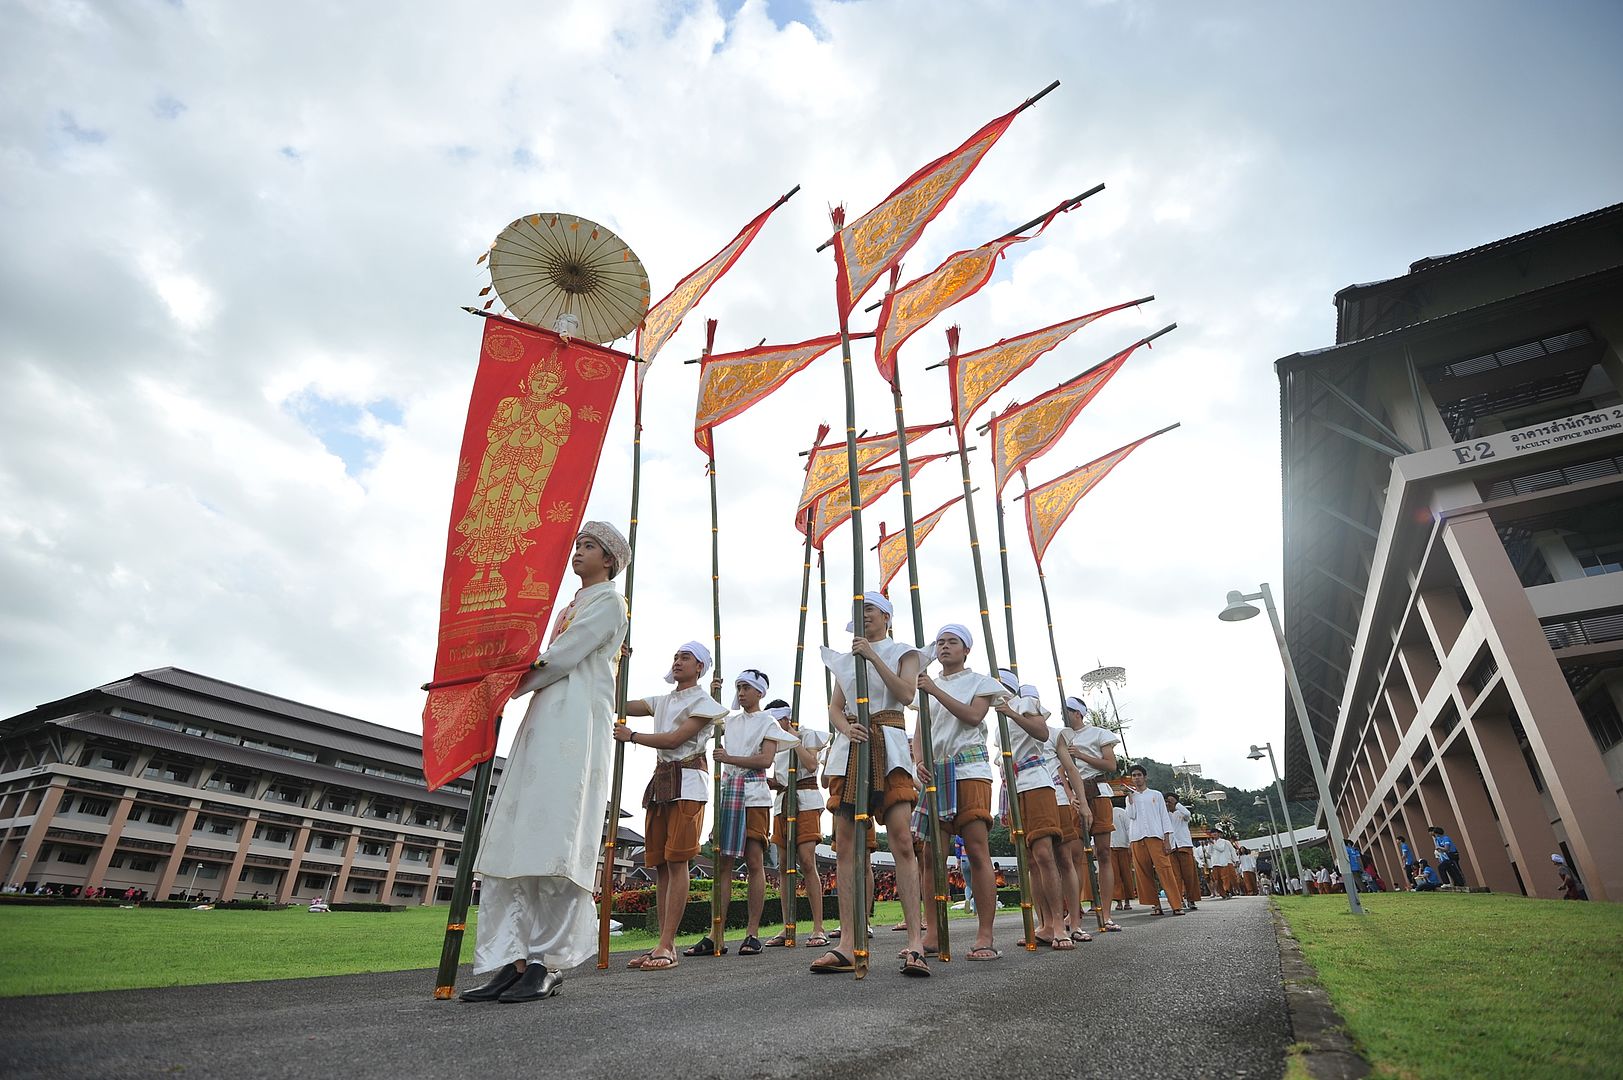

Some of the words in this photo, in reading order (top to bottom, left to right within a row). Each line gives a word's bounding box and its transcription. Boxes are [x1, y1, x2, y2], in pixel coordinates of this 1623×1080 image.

[1510, 414, 1609, 442] อาคารสำนักวิชา
[1515, 439, 1551, 451] FACULTY
[1553, 431, 1582, 443] OFFICE
[1583, 422, 1622, 436] BUILDING
[1452, 441, 1496, 465] E2
